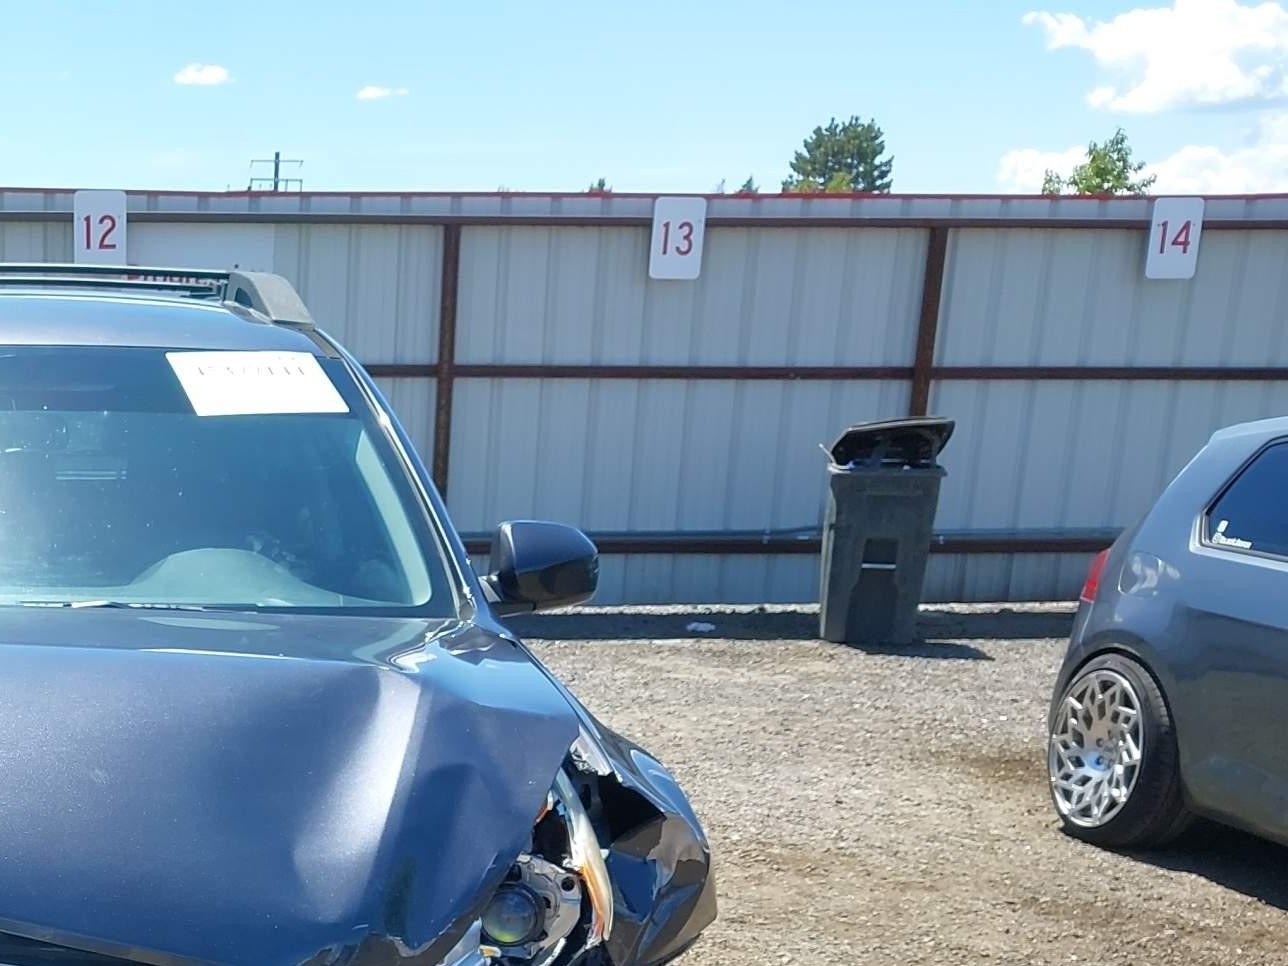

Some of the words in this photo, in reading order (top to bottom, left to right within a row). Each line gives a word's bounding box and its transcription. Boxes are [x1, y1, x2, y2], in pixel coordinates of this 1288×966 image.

[83, 214, 117, 251] 12
[661, 220, 693, 257] 13
[1157, 220, 1191, 255] 14
